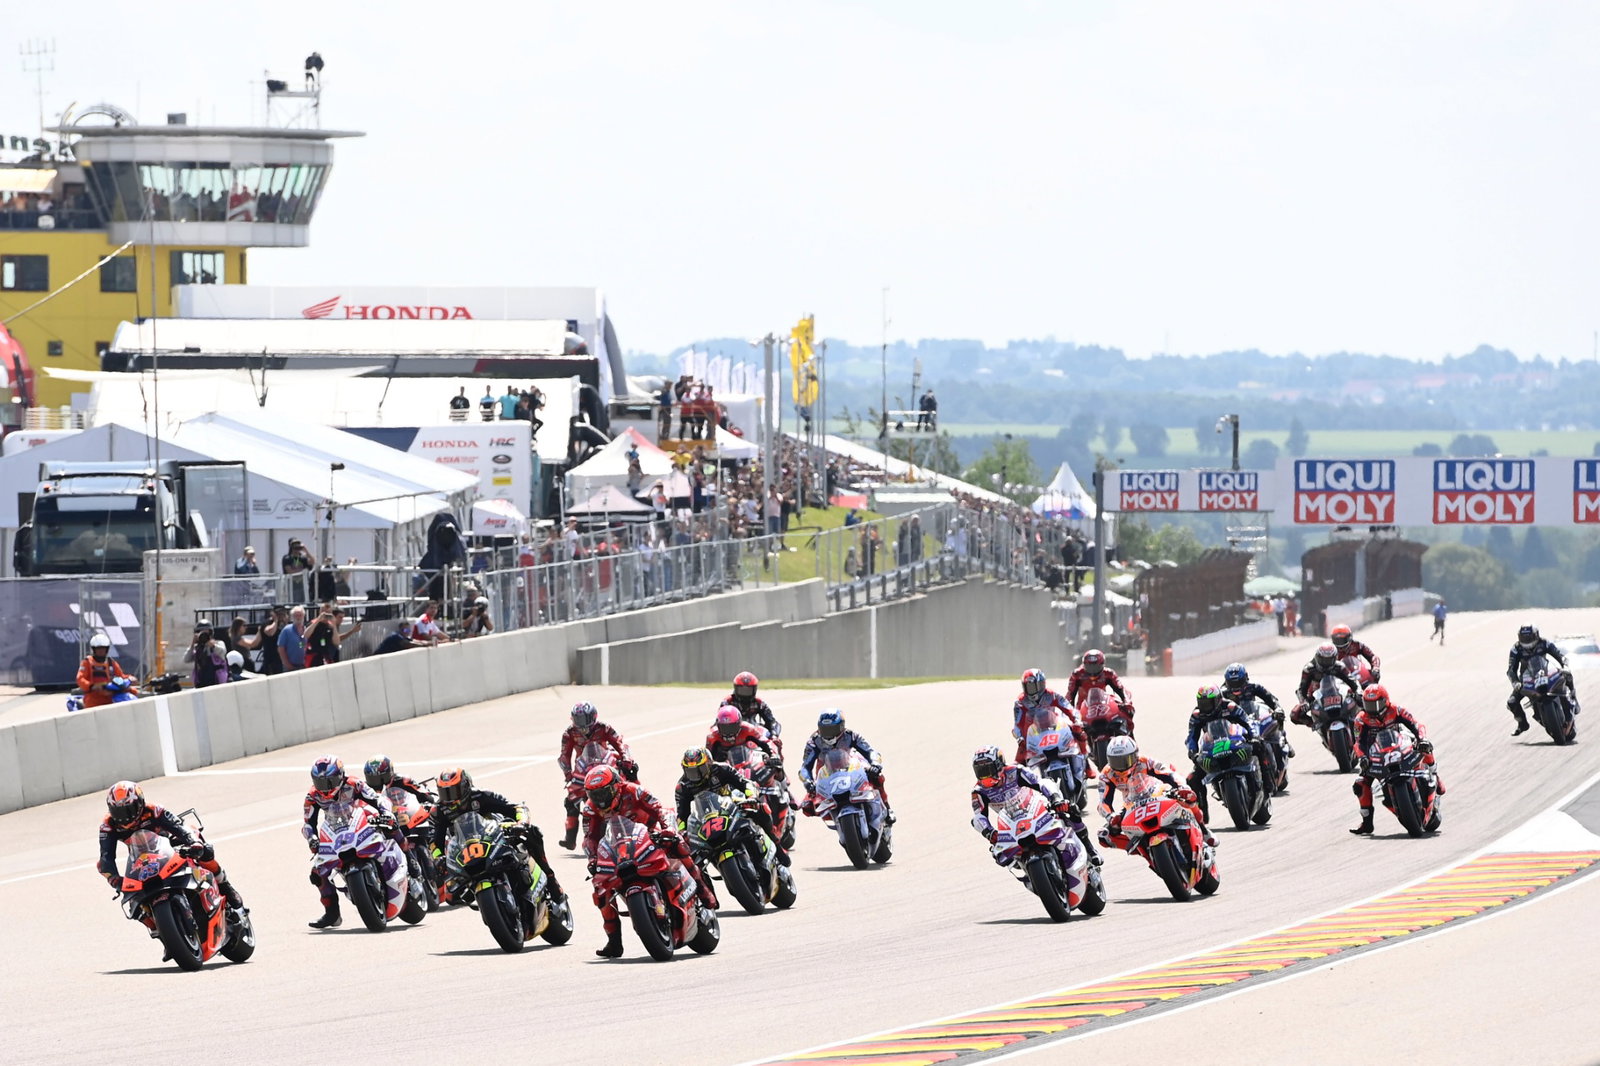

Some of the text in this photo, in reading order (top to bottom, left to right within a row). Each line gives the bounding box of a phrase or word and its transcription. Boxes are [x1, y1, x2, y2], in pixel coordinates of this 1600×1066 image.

[343, 305, 474, 320] HONDA
[422, 440, 479, 448] HONDA
[1122, 473, 1177, 491] LIQUI
[1201, 473, 1256, 491] LIQUI
[1299, 462, 1391, 491] LIQUI
[1438, 462, 1530, 491] LIQUI
[1122, 492, 1178, 510] MOLY
[1201, 492, 1257, 510] MOLY
[1299, 494, 1393, 523] MOLY
[1437, 494, 1533, 523] MOLY
[1038, 734, 1059, 747] 49
[1213, 740, 1231, 754] 21
[1384, 751, 1402, 766] 12
[1135, 801, 1161, 824] 93
[702, 817, 724, 838] 72
[462, 843, 484, 864] 10
